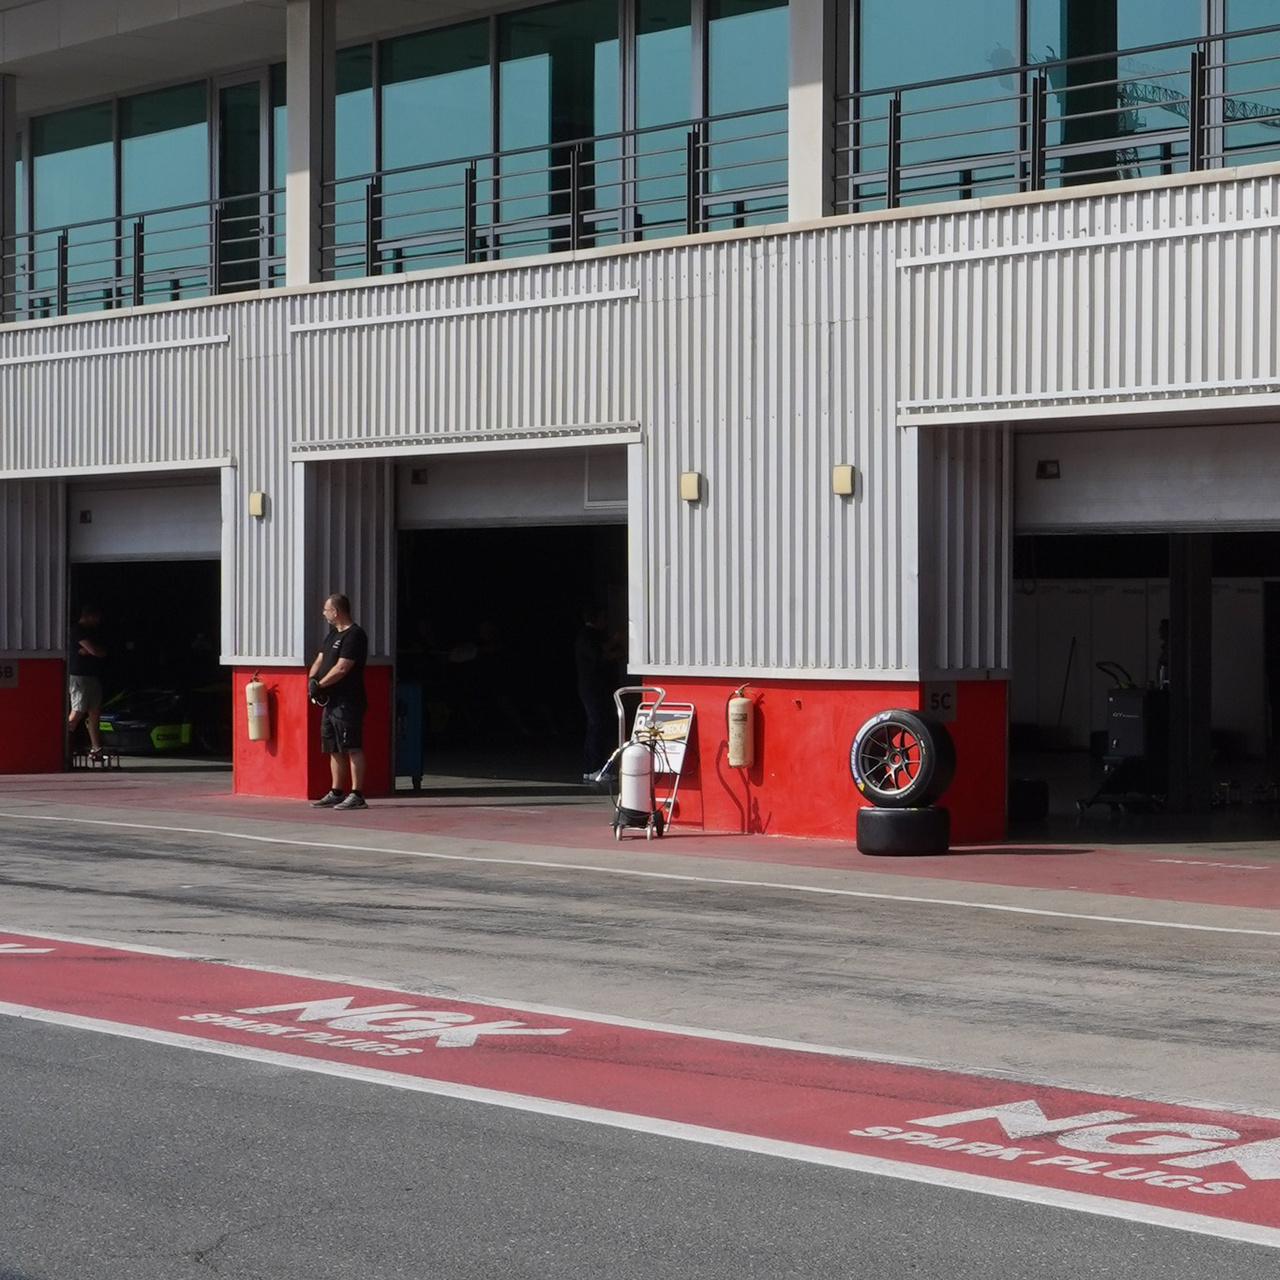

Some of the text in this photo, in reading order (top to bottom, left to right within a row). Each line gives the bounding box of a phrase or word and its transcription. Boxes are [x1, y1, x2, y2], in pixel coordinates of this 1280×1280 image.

[930, 691, 952, 710] 5C
[177, 1012, 425, 1057] SPARK PLUGS
[231, 995, 572, 1048] NGK
[848, 1125, 1248, 1196] SPARK PLUGS
